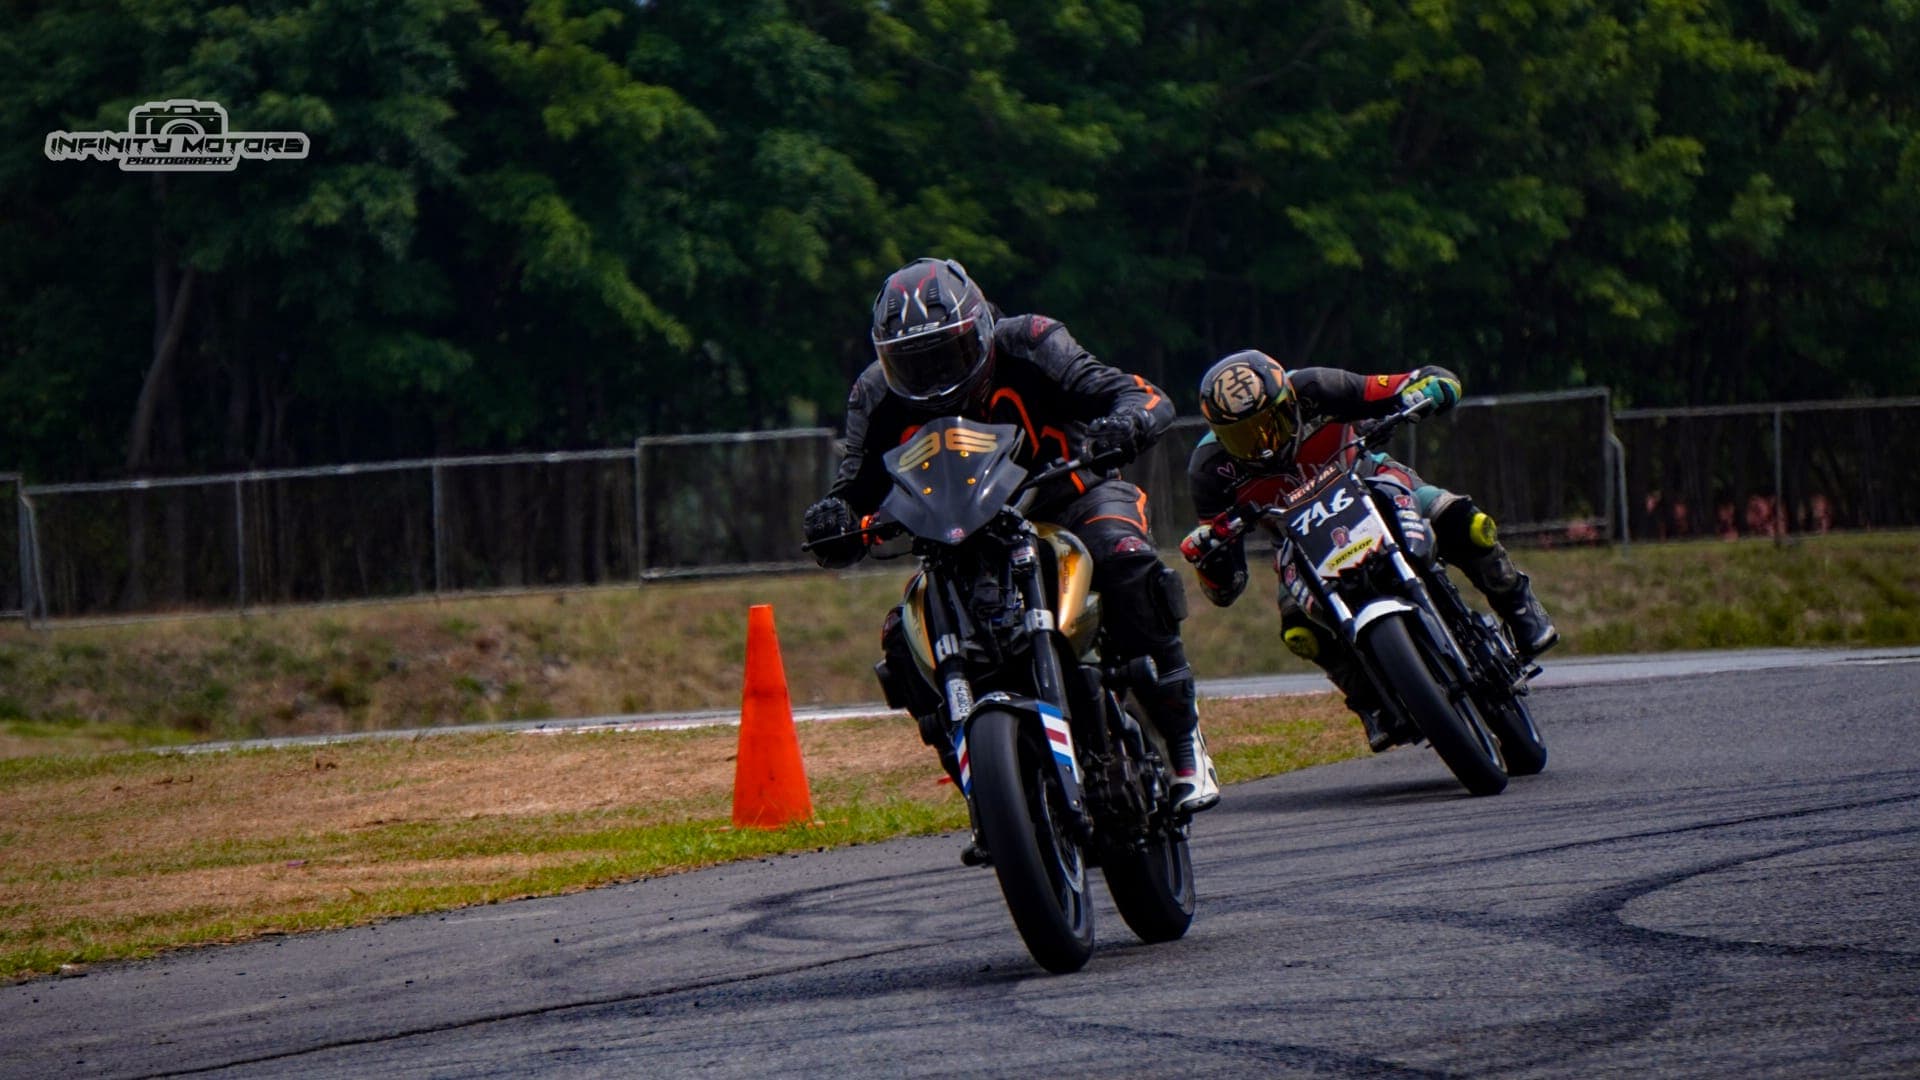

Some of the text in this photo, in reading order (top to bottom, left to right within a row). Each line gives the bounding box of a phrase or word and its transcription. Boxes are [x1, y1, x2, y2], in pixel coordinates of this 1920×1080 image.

[1288, 466, 1337, 502] RENTAL
[1290, 487, 1355, 536] 716
[1335, 538, 1374, 566] DUNLOP
